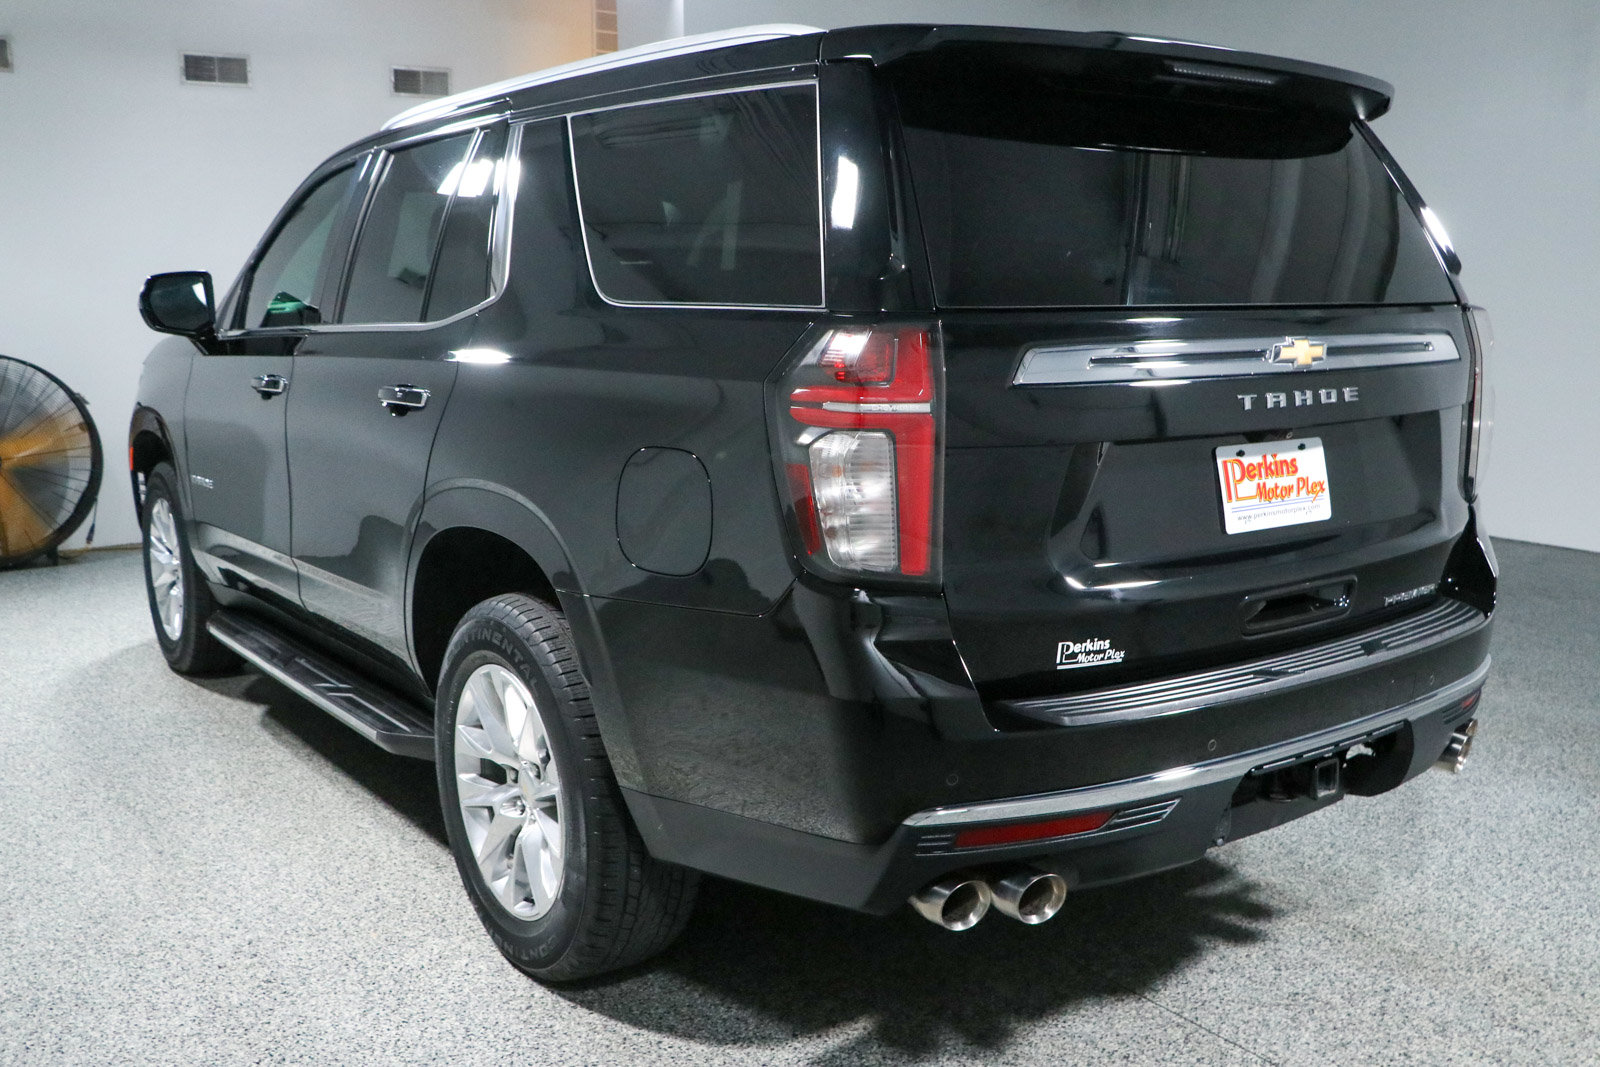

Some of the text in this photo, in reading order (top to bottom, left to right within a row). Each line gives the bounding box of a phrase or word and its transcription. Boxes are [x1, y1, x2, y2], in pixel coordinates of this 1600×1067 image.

[1236, 387, 1359, 411] TAHOE
[1222, 453, 1299, 504] Perkins
[1256, 476, 1326, 504] Motor Plex
[1237, 504, 1322, 521] www.perkinsmotorplex.com
[1383, 583, 1438, 607] PREMIER
[1056, 638, 1111, 664] Perkins
[1076, 648, 1126, 664] Motor Plex
